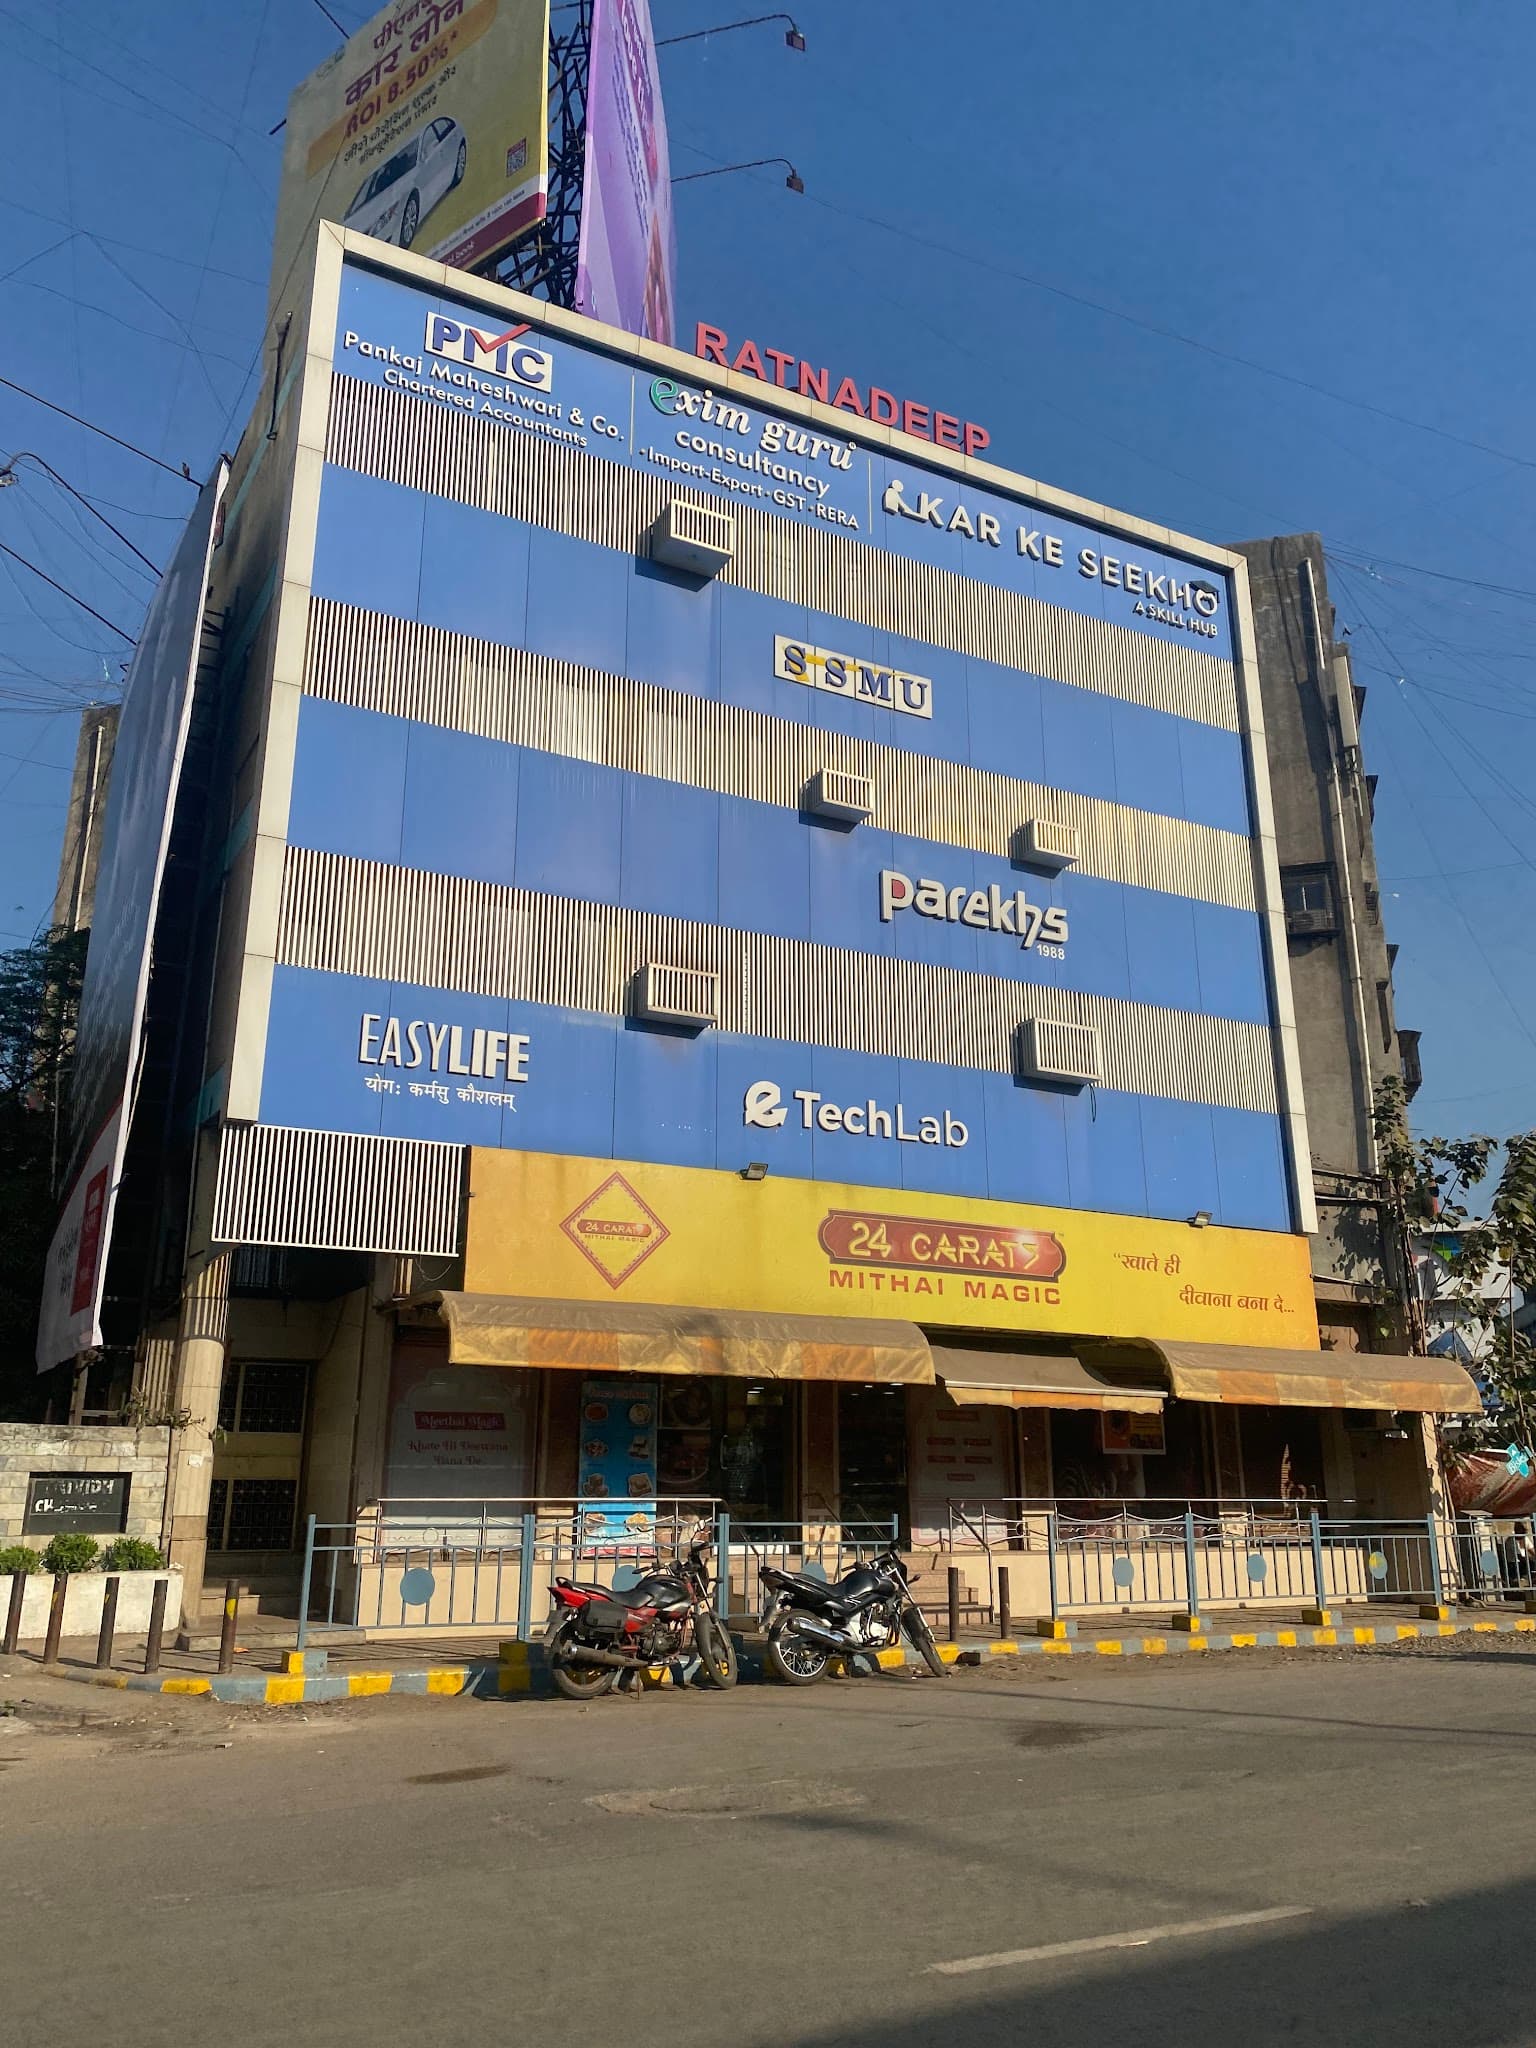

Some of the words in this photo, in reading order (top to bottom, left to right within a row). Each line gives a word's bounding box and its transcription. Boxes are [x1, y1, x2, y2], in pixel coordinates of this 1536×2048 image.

[345, 44, 402, 105] कार
[410, 0, 463, 52] लोन
[347, 96, 381, 138] ROI
[432, 316, 545, 383] PMC
[344, 330, 423, 375] Pankaj
[430, 361, 562, 418] Maheshwari
[569, 407, 585, 426] &
[591, 415, 624, 440] Co.
[384, 369, 475, 410] Chartered
[480, 403, 588, 448] Accountants
[696, 322, 991, 456] RATNADEEP
[650, 377, 750, 435] exim
[760, 414, 857, 470] guru
[676, 430, 830, 500] consultancy
[773, 489, 806, 512] GST
[816, 502, 859, 530] RERA
[1017, 526, 1064, 568] KE
[1079, 548, 1219, 617] SEEKHO
[1134, 601, 1144, 614] A
[1147, 604, 1186, 628] SKILL
[1189, 616, 1218, 638] HUB
[784, 643, 928, 710] SSMU
[1036, 943, 1065, 960] 1988
[358, 1013, 530, 1082] EASYLIFE
[408, 1080, 450, 1104] कर्मसु
[456, 1083, 517, 1112] कौशलम्
[794, 1090, 969, 1147] TechLab
[585, 1222, 599, 1232] 24
[849, 1221, 892, 1258] 24
[829, 1270, 944, 1296] MITHAI
[963, 1280, 1061, 1305] MAGIC
[1164, 1254, 1182, 1276] ही
[1179, 1284, 1232, 1308] दीवाना
[1237, 1295, 1269, 1311] बना
